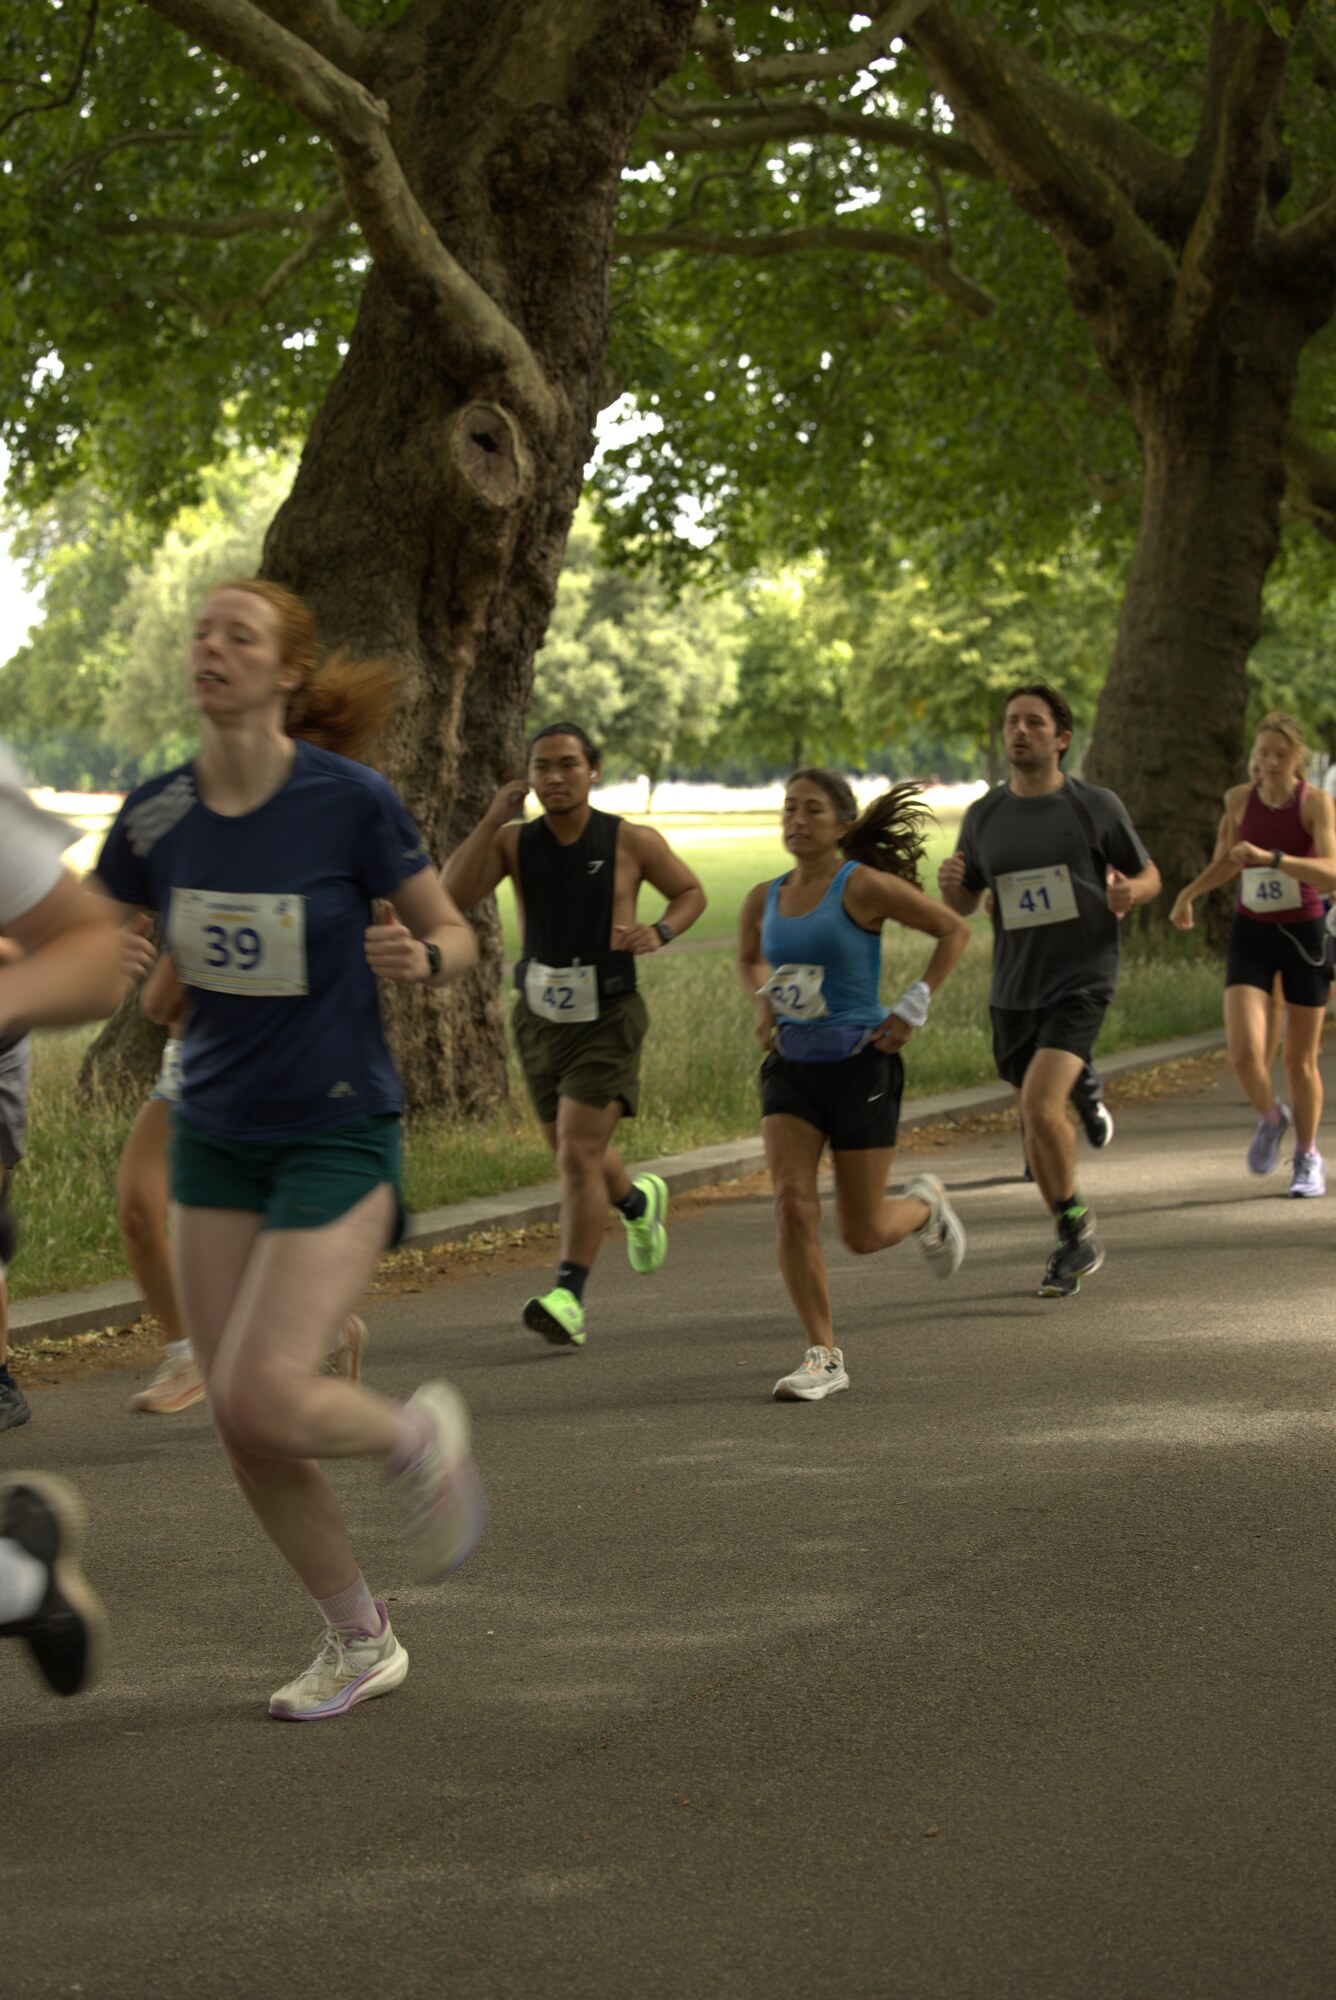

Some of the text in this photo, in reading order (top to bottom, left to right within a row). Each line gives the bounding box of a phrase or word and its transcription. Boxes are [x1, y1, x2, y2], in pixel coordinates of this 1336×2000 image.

[1018, 886, 1051, 913] 41
[1255, 880, 1283, 901] 48
[202, 925, 263, 971] 39
[542, 986, 575, 1010] 42
